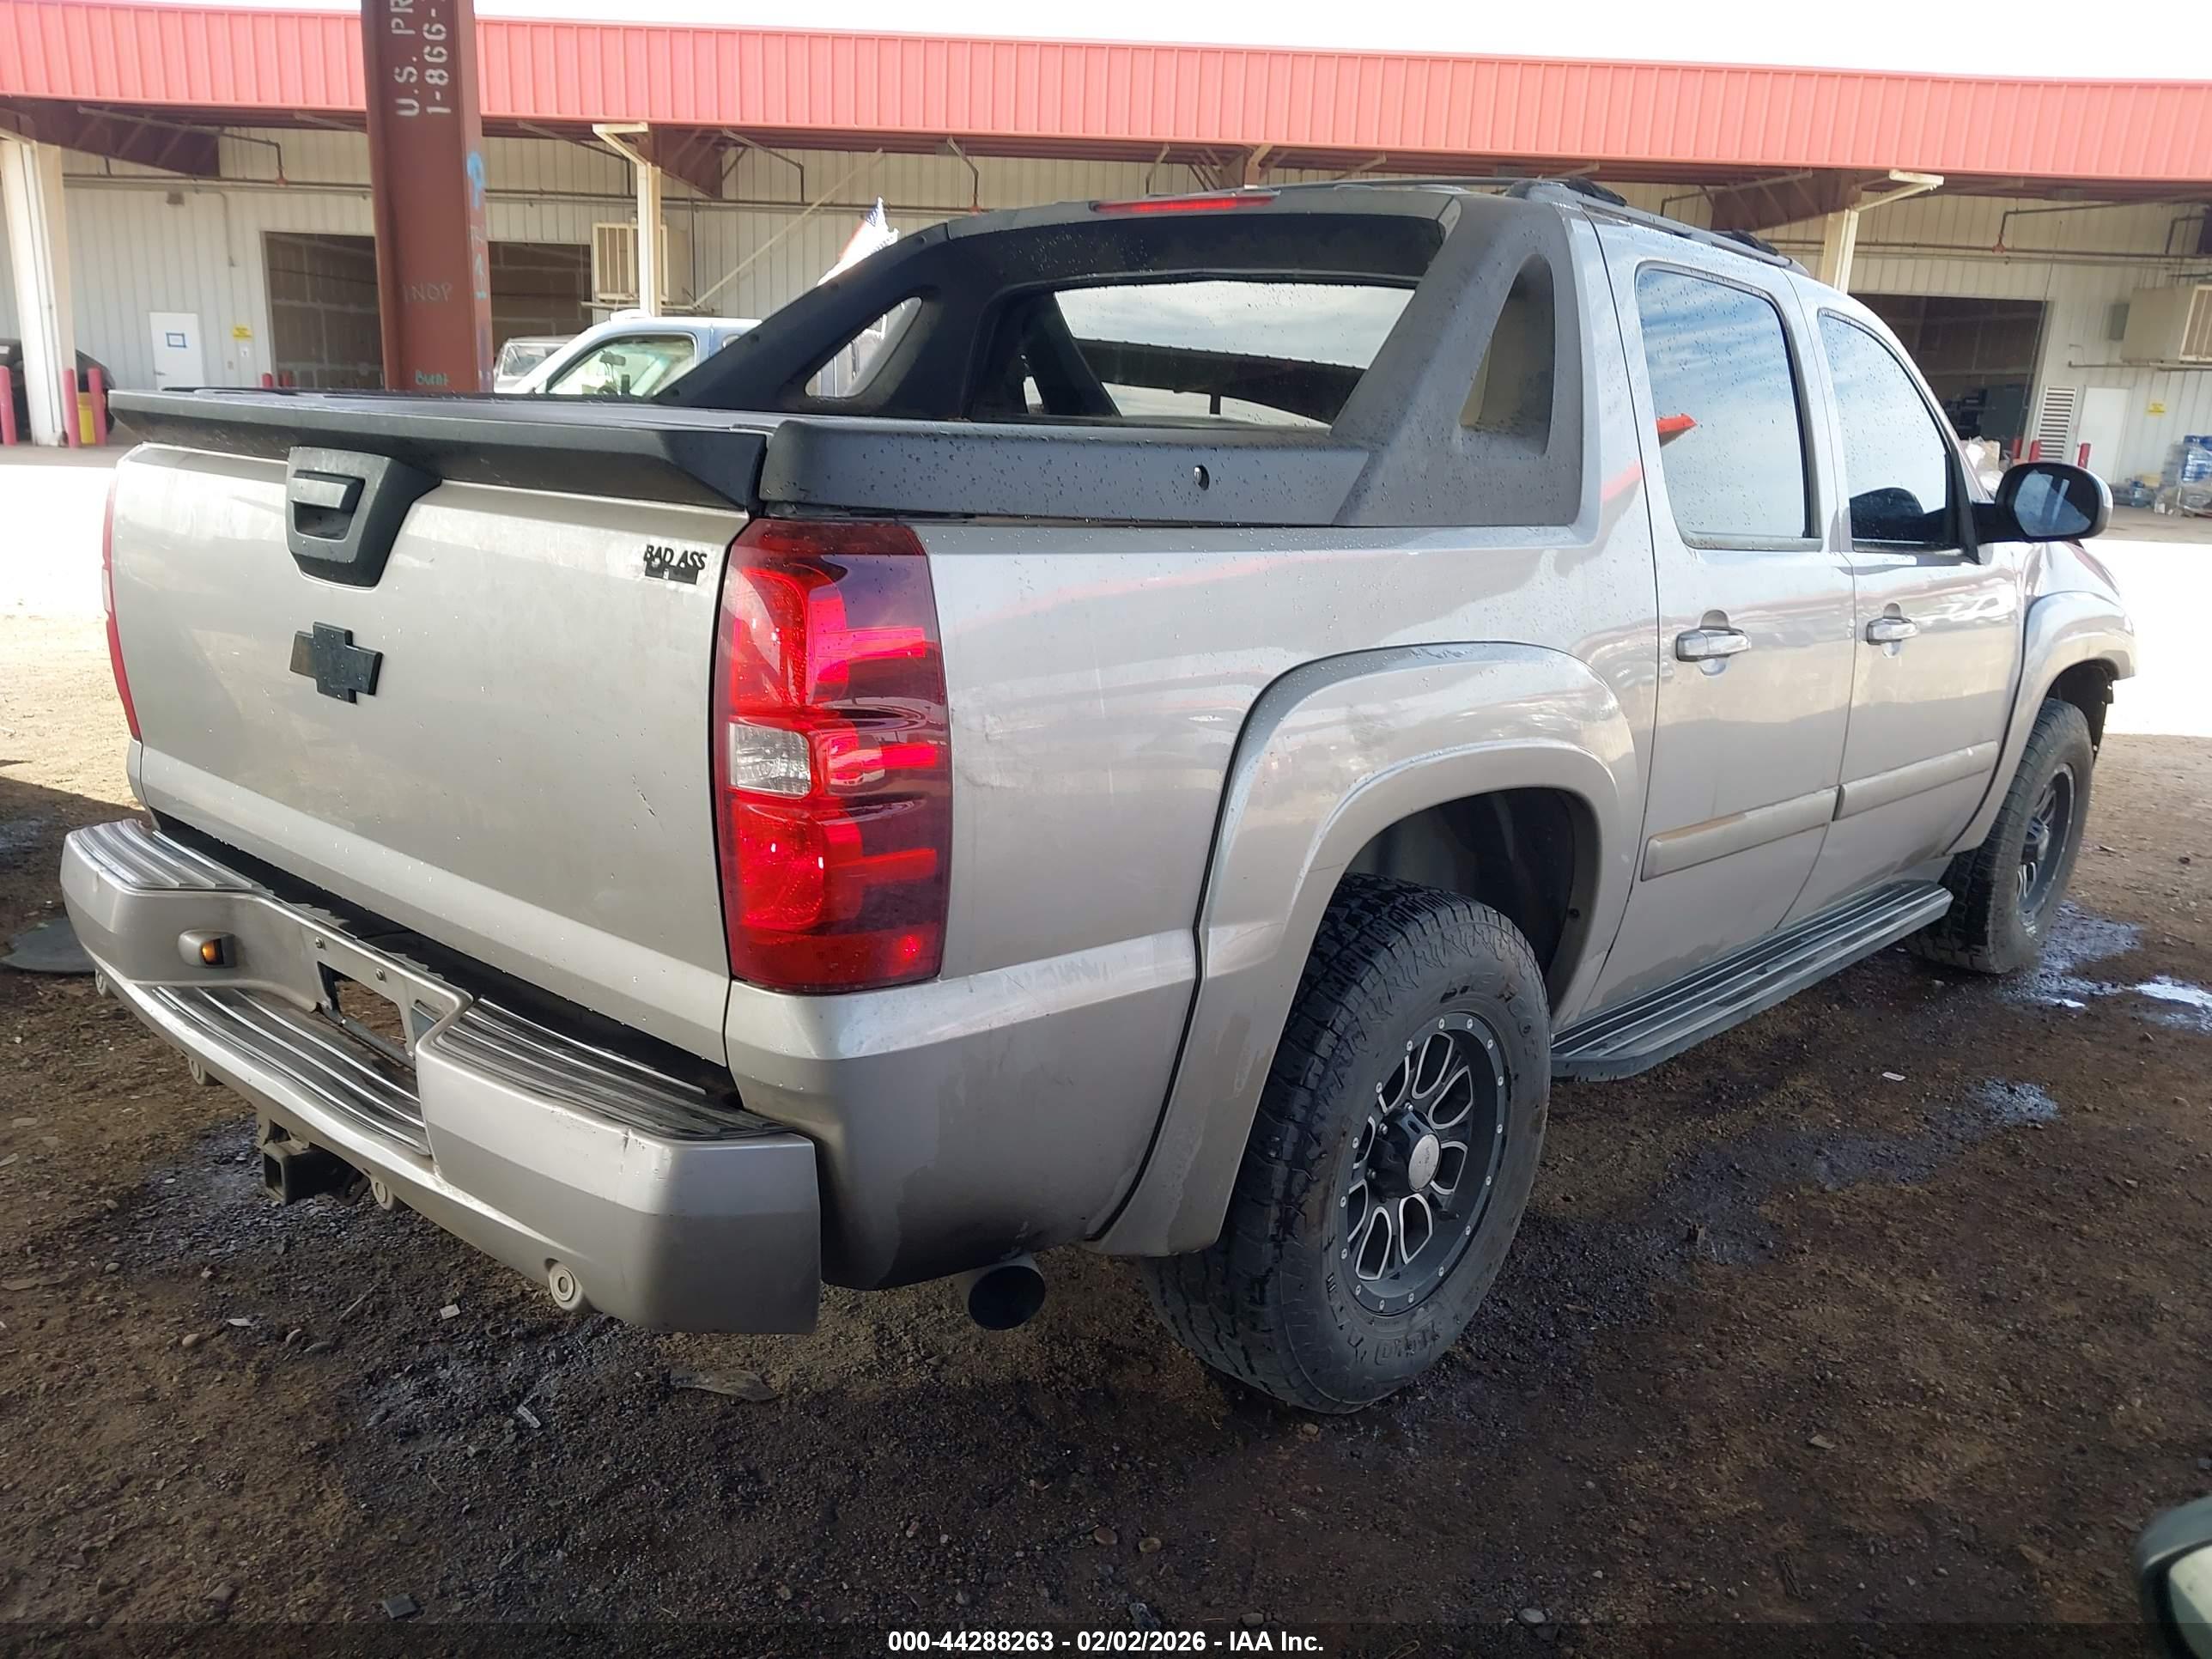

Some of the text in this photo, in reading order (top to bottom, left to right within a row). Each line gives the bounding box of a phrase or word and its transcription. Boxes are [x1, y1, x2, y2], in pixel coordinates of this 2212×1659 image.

[394, 56, 420, 117] U.S.
[421, 0, 452, 113] 1-866-
[643, 544, 708, 571] BAD ASS
